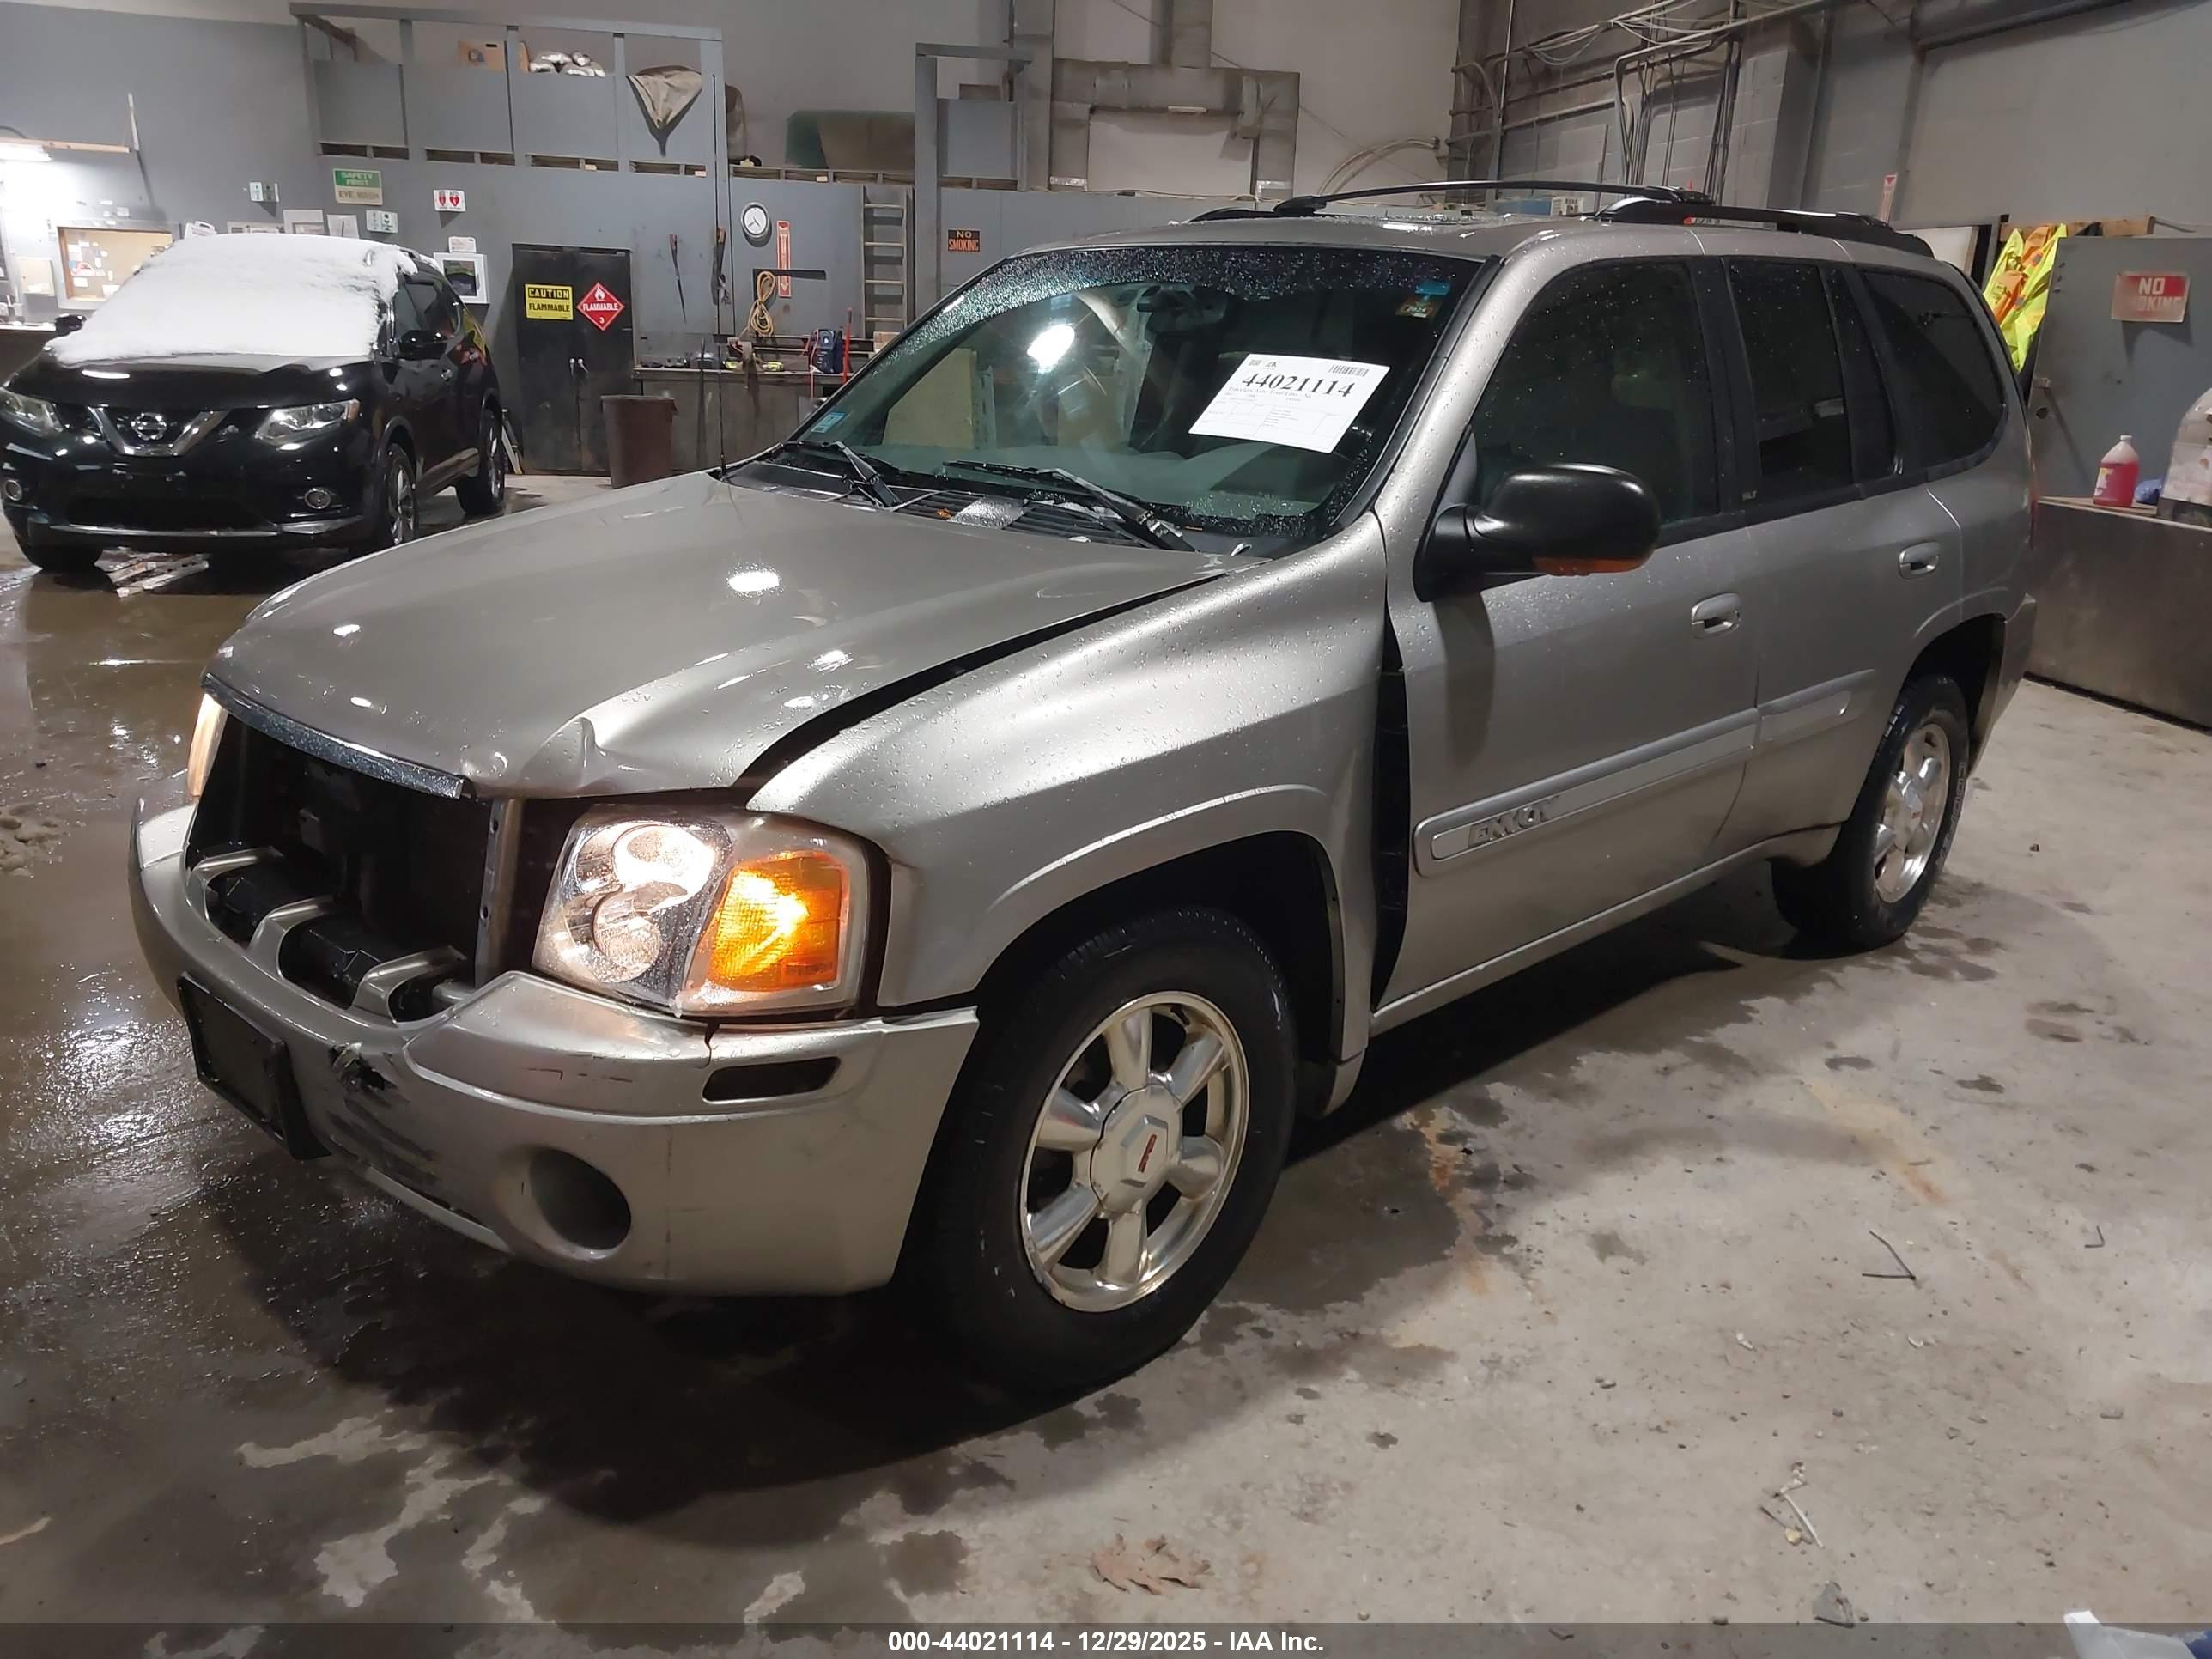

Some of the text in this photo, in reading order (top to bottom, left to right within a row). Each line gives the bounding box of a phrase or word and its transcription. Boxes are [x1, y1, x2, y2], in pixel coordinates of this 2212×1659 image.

[338, 190, 353, 198] EYE
[957, 230, 972, 239] NO
[948, 239, 979, 252] SMOKING
[2138, 277, 2166, 295] NO
[528, 288, 569, 299] CAUTION
[529, 302, 570, 313] FLAMMABLE
[583, 302, 618, 312] FLAMMABLE
[1242, 372, 1355, 398] 44021114
